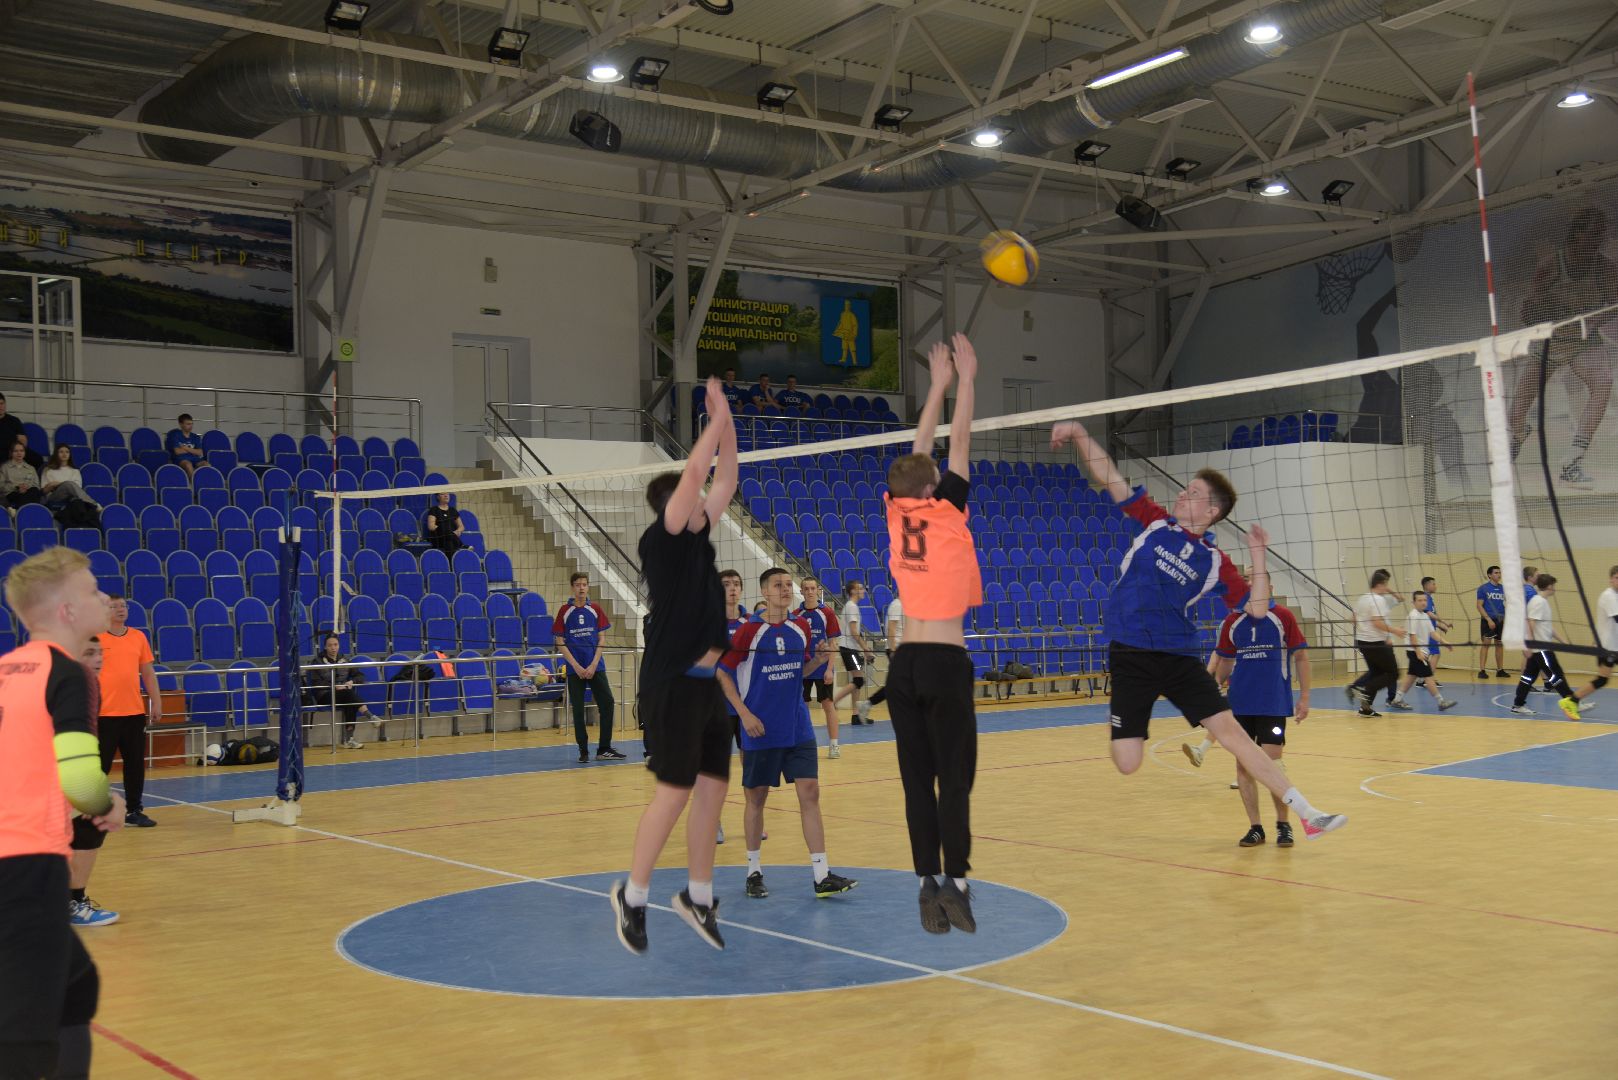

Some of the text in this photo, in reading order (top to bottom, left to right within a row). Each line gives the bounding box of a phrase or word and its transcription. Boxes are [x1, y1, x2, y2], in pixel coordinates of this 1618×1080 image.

[136, 239, 248, 267] ЦЕНТР
[689, 295, 790, 314] АИНИСТРАЦИЯ
[707, 312, 781, 327] ТОШИНСКОГО
[701, 326, 798, 342] УНИЦИПАЛЬНОГО
[698, 338, 737, 352] АЙОНА
[1251, 627, 1256, 642] 1
